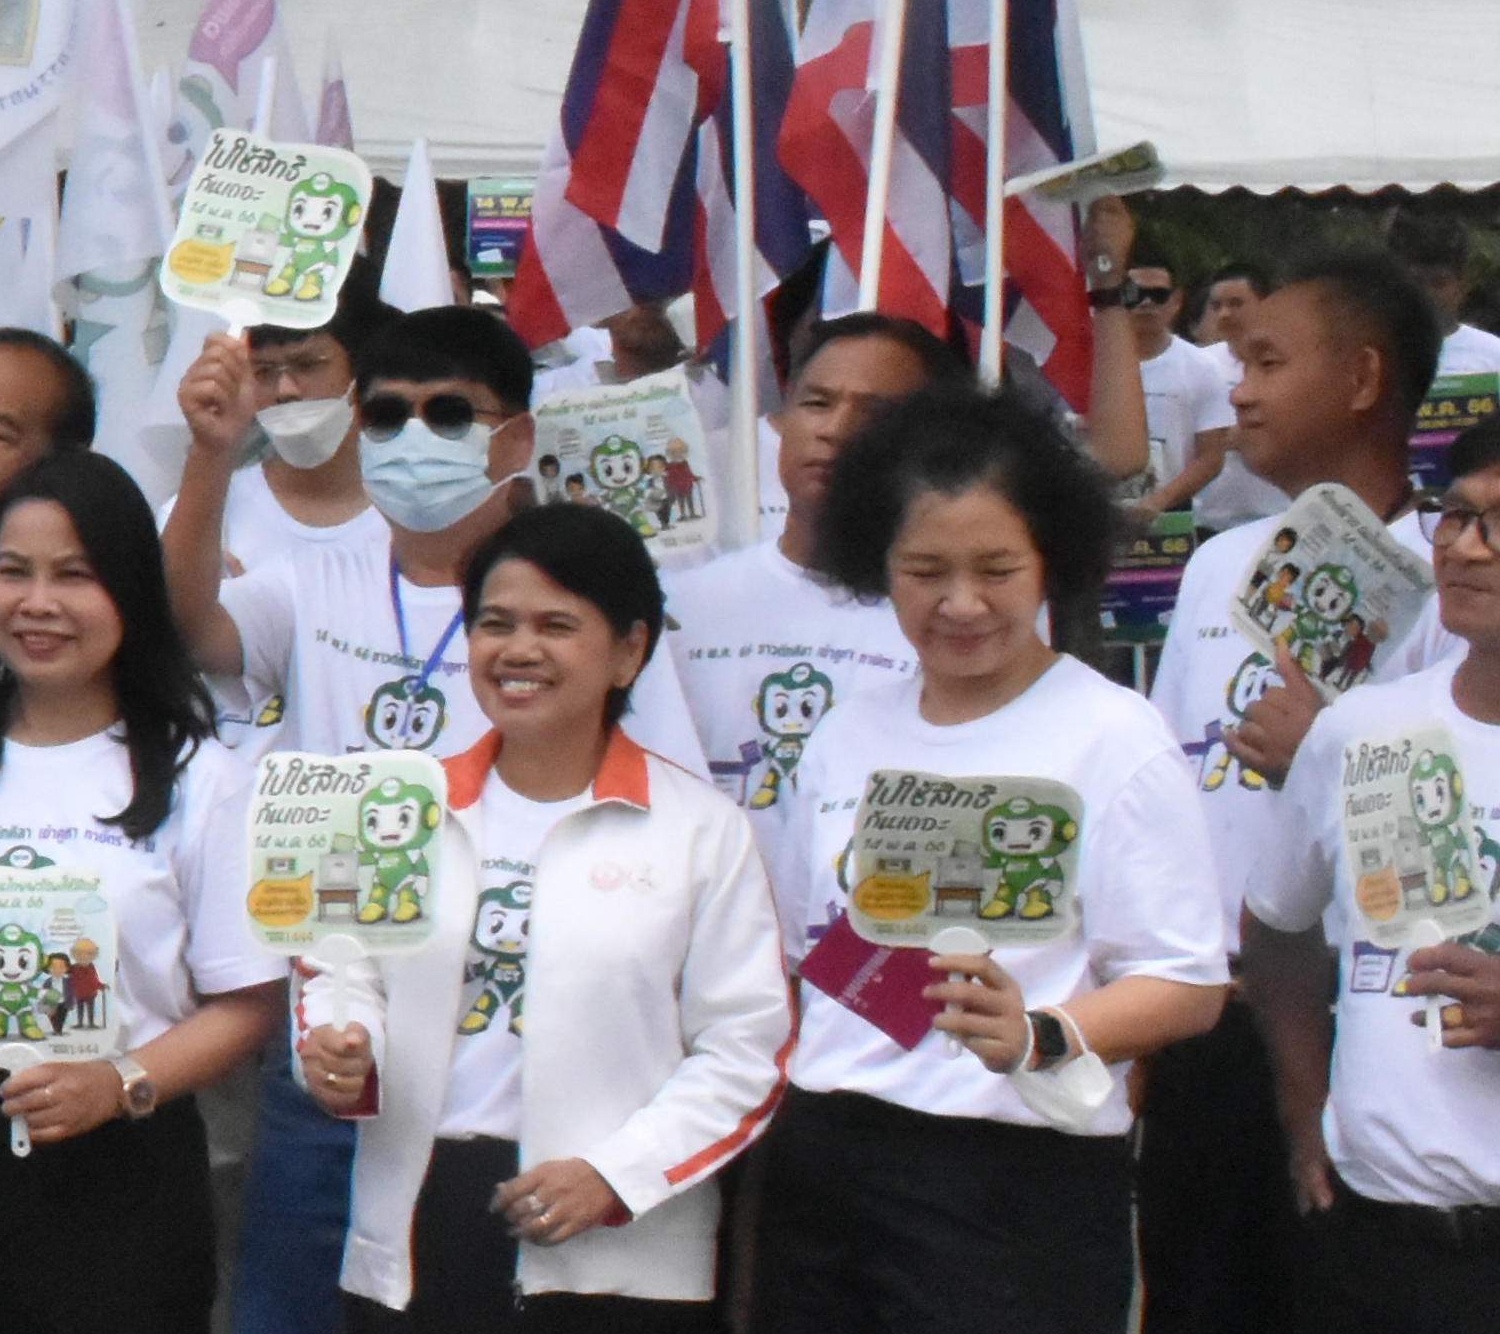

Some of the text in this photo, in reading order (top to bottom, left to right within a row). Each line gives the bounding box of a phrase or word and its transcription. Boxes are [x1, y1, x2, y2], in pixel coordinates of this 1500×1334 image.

[205, 133, 307, 181] ไปใช้สิทธิ
[259, 758, 373, 796] ไปใช้สิทธิ
[867, 773, 998, 809] ไปใช้สิทธิ
